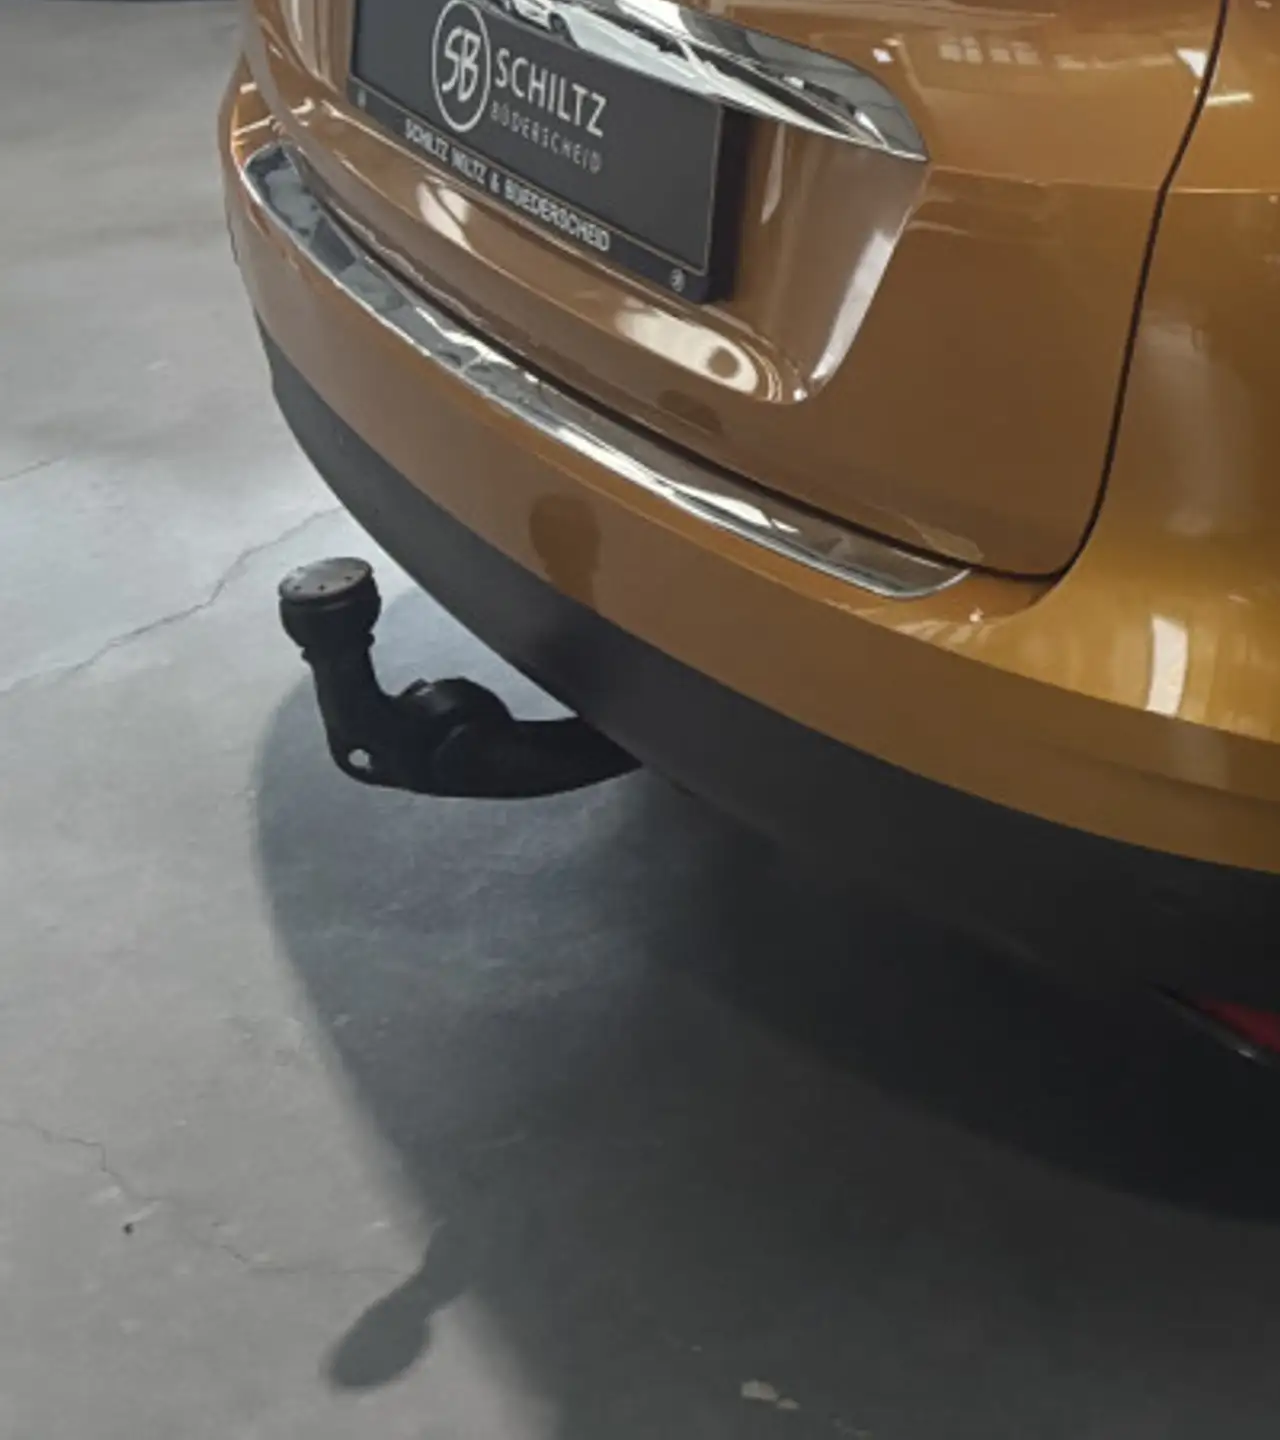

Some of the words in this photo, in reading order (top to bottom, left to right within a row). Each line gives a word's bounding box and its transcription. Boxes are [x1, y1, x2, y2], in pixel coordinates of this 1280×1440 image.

[495, 47, 608, 138] SCHILTZ
[404, 118, 450, 162] SCHILTZ
[452, 147, 489, 185] WILTZ
[490, 171, 500, 193] &
